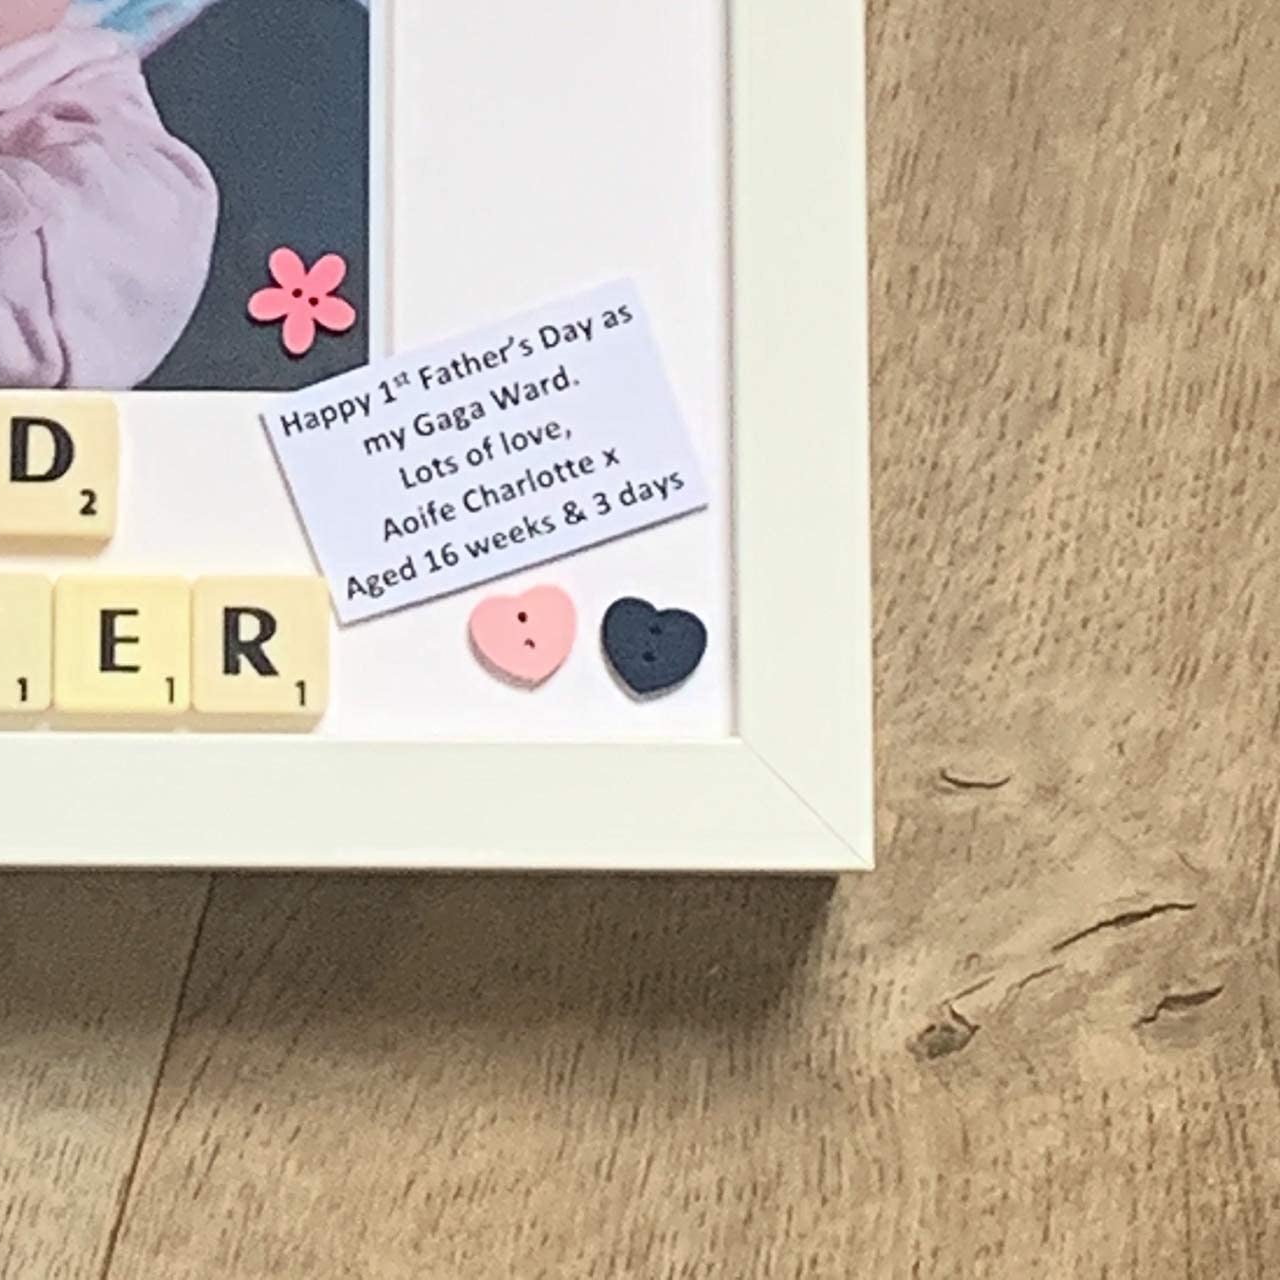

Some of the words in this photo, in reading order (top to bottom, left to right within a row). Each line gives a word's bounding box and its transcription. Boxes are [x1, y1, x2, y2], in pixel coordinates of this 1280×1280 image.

[280, 393, 371, 437] Happy
[539, 317, 593, 350] Day
[602, 304, 633, 329] as
[363, 427, 405, 455] my
[413, 401, 486, 437] Gaga
[490, 365, 580, 411] Ward.
[384, 500, 456, 543] Aoife
[463, 455, 595, 514] Charlotte
[602, 447, 620, 467] x
[399, 456, 459, 489] Lots
[466, 436, 493, 467] of
[500, 421, 572, 456] love,
[78, 489, 99, 516] 2
[347, 555, 417, 600] Aged
[424, 542, 459, 573] 16
[464, 516, 557, 559] weeks
[562, 501, 588, 525] &
[593, 492, 612, 516] 3
[619, 471, 684, 507] days
[15, 676, 30, 703] 1
[163, 676, 176, 704] 1
[293, 679, 308, 707] 1
